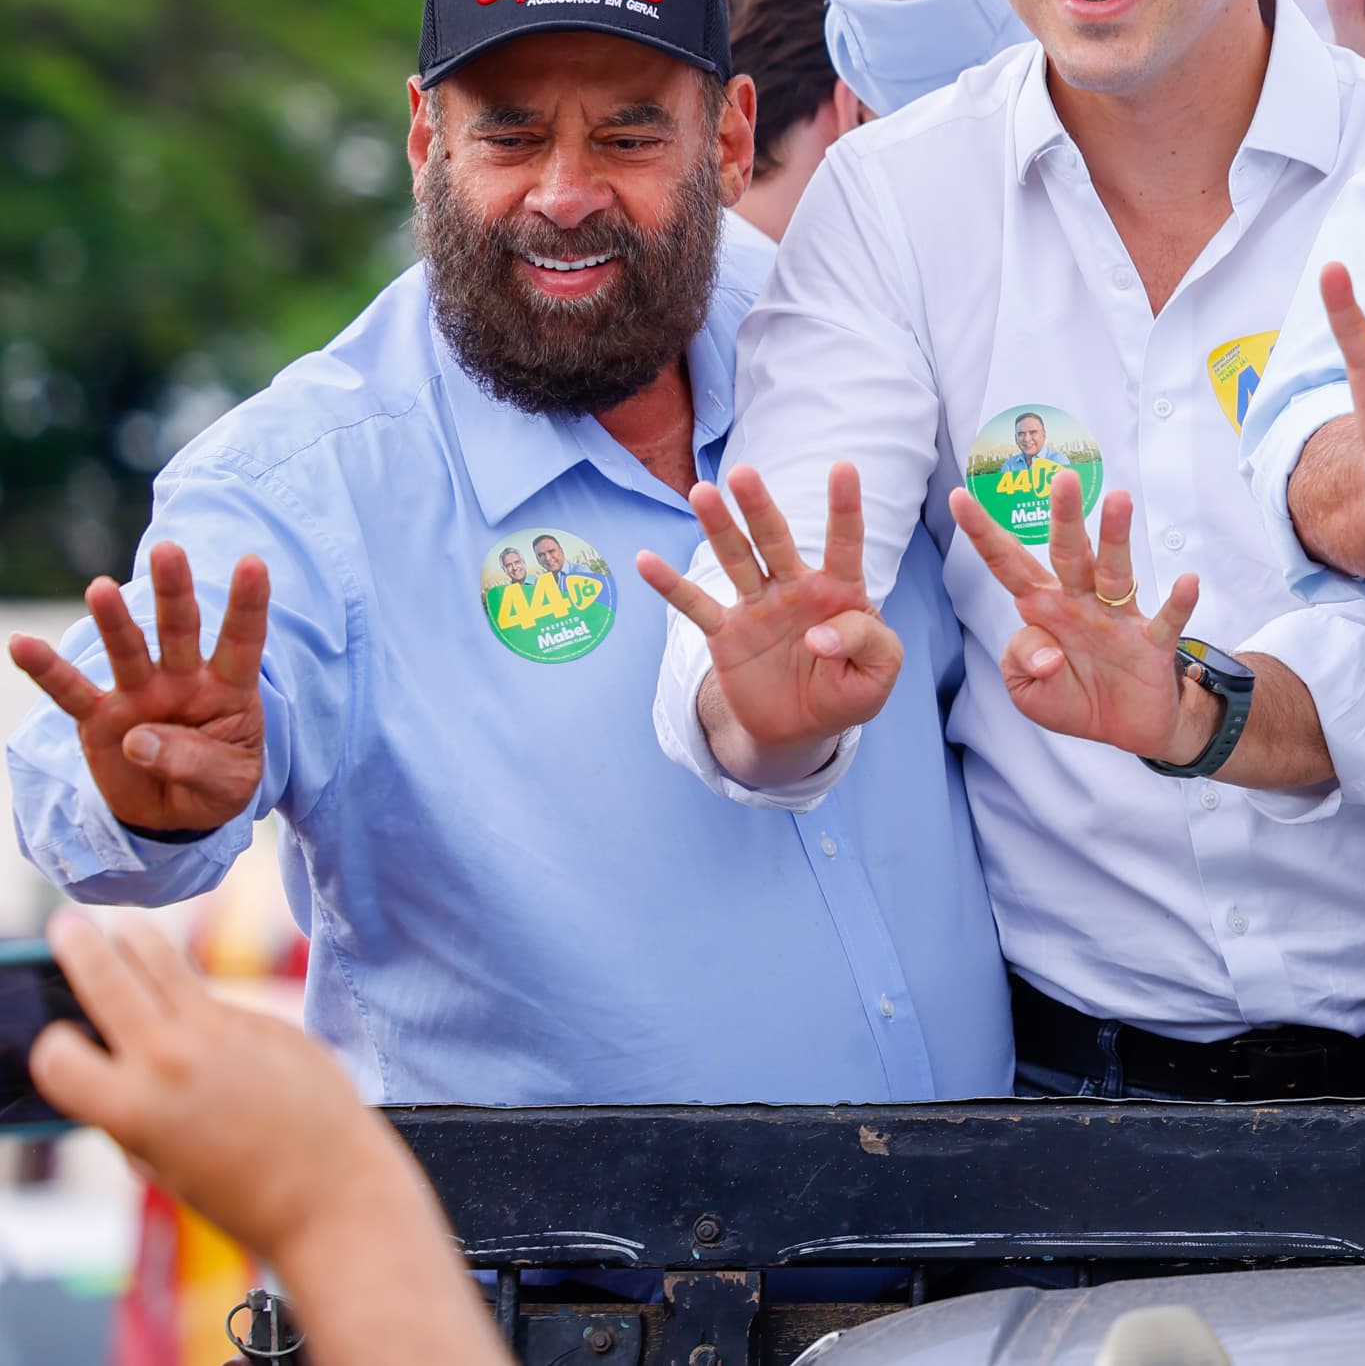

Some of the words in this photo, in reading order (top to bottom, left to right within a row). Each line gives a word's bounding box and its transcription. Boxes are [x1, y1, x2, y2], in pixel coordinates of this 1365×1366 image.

[996, 470, 1033, 495] 44
[497, 572, 571, 630] 44
[573, 579, 596, 606] Já
[537, 621, 590, 649] Mabel
